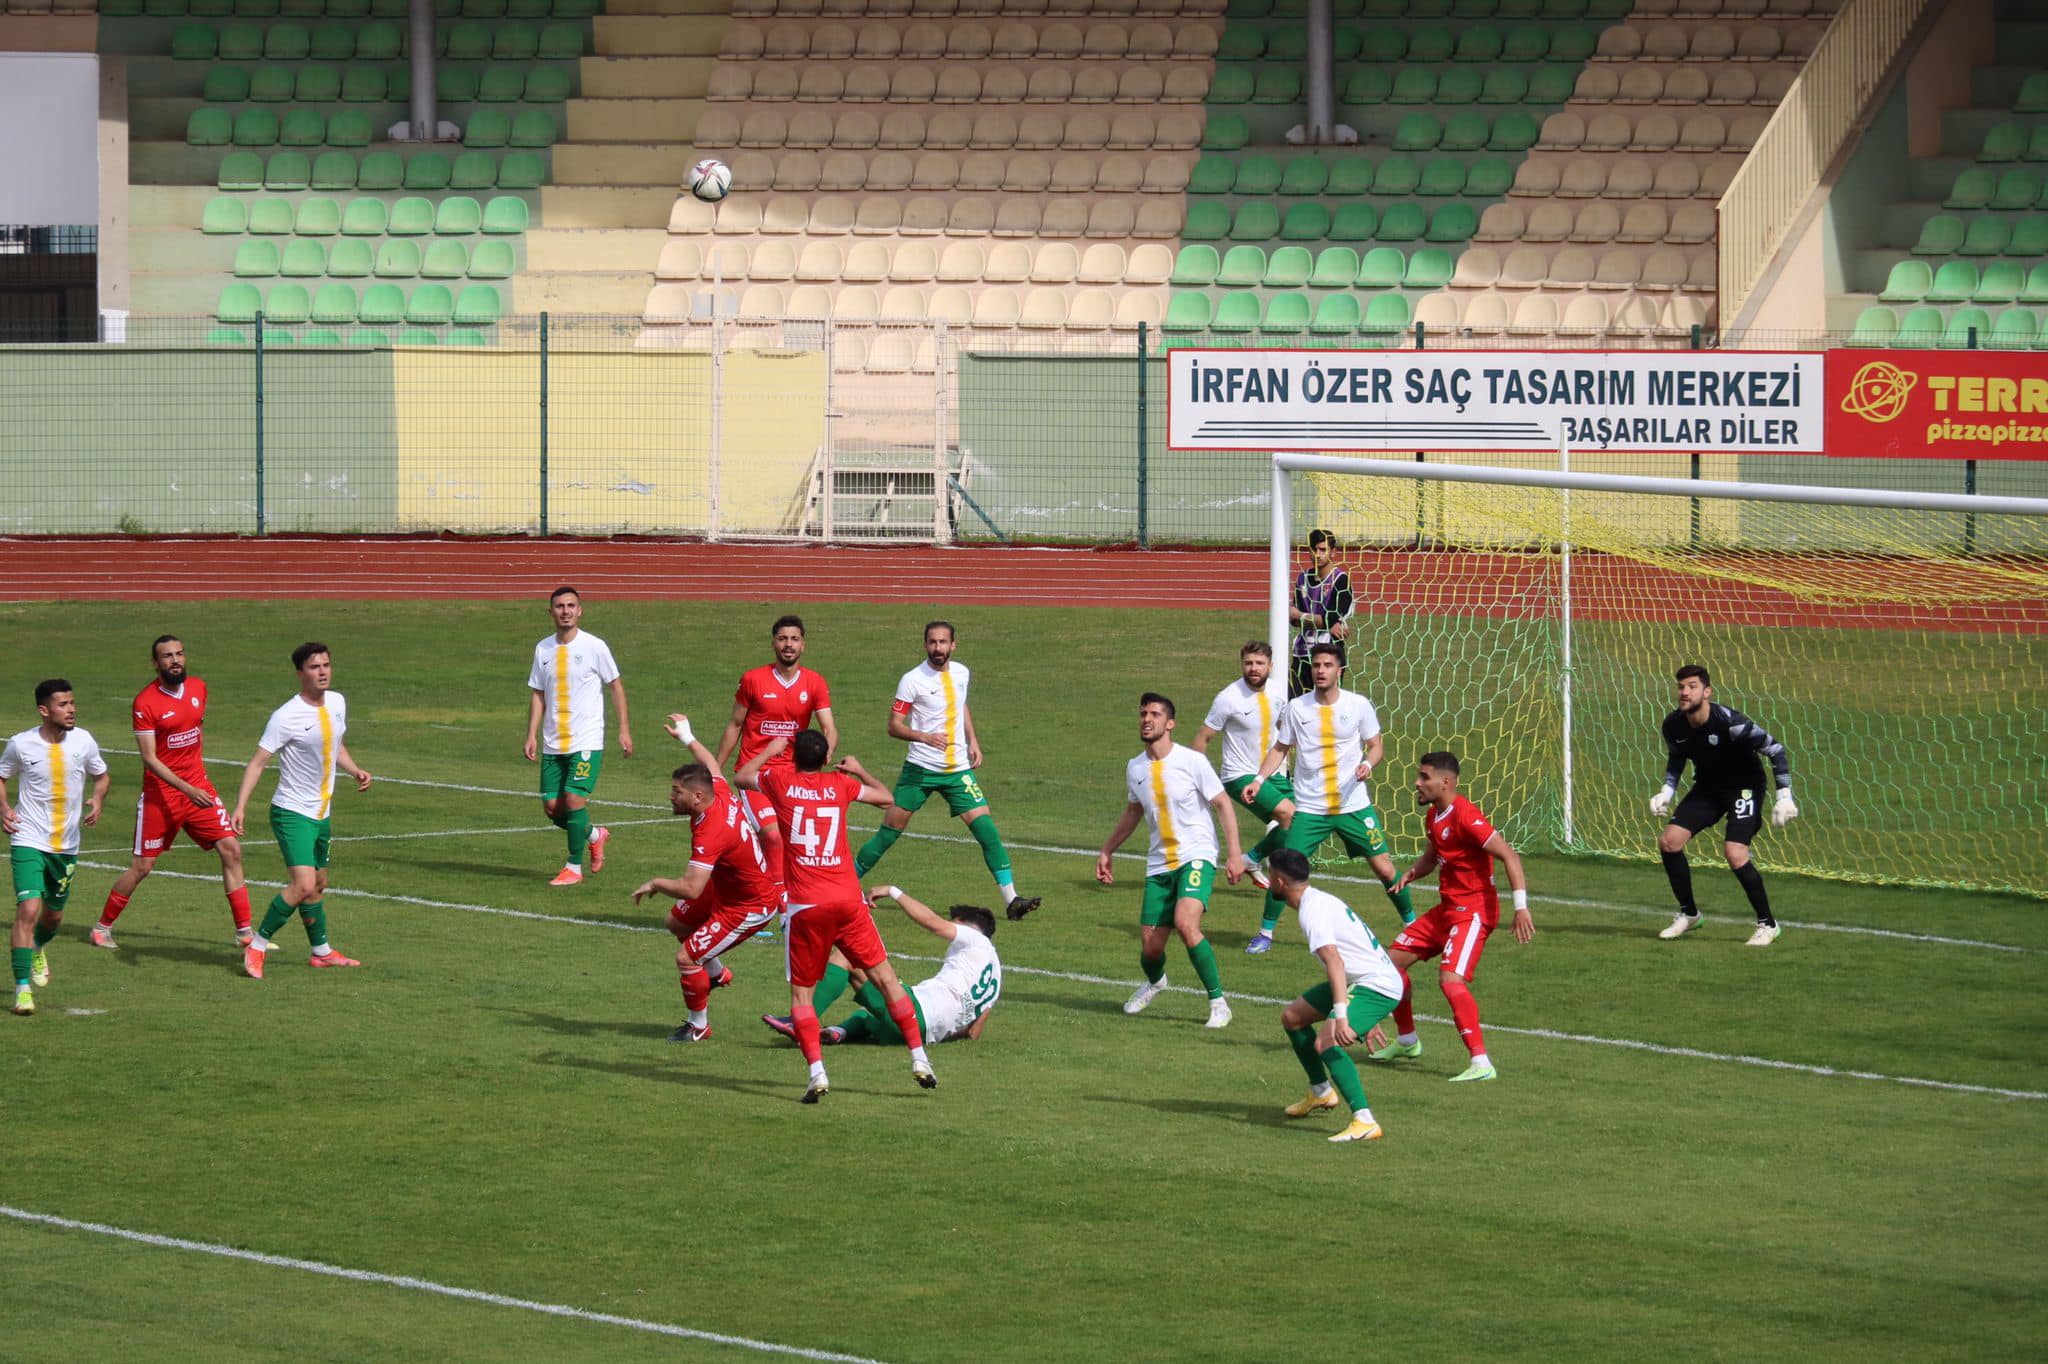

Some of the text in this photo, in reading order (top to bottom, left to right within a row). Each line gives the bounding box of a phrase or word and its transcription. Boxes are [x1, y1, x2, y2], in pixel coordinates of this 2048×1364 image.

[1191, 359, 1800, 413] İRFAN ÖZER SAÇ TASARIM MERKEZİ
[1928, 376, 2048, 413] TERR
[1561, 413, 1799, 448] BAŞARILAR DİLER
[576, 762, 591, 777] 52
[1735, 799, 1754, 816] 91
[790, 806, 840, 856] 47
[1366, 828, 1383, 845] 23
[693, 926, 713, 951] 24
